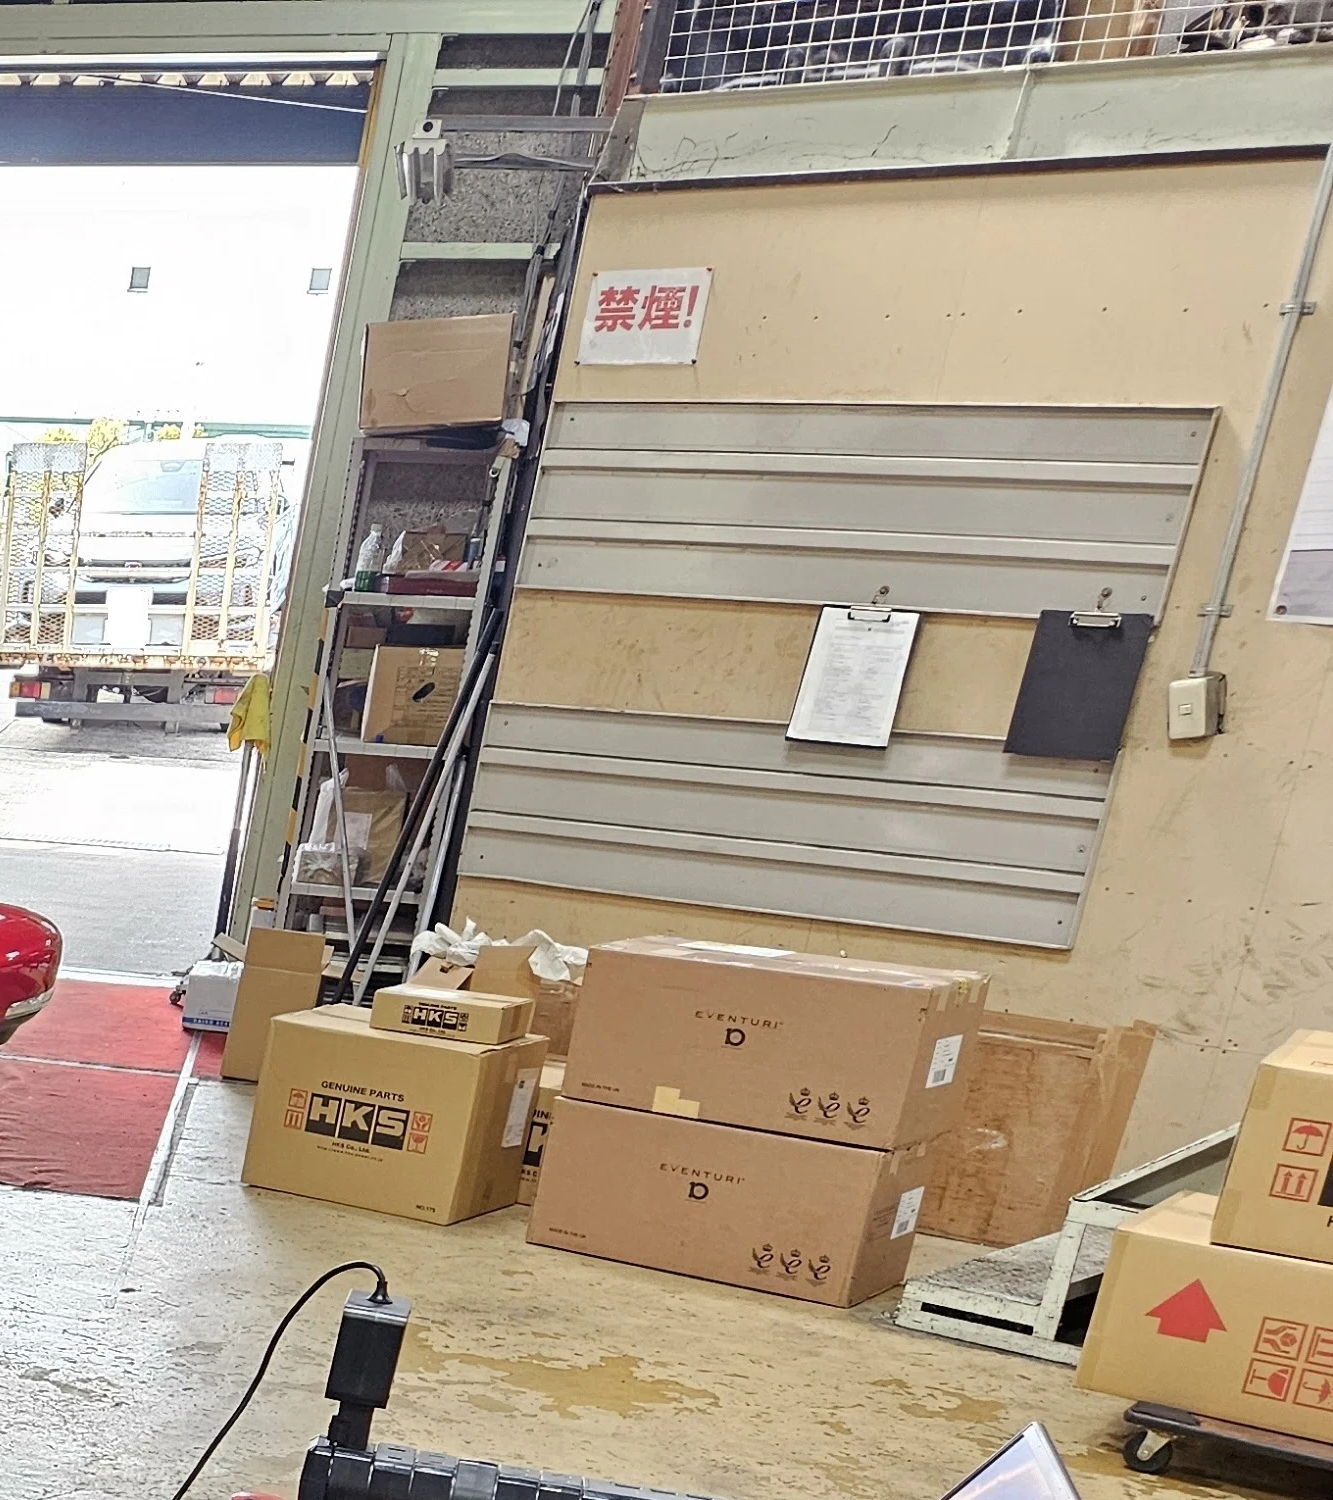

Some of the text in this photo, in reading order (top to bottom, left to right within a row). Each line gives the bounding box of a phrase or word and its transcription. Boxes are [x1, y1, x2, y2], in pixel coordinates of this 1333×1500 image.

[594, 285, 699, 332] 禁煙!
[413, 1007, 458, 1026] HKS
[695, 1010, 779, 1030] EVENTURI
[321, 1080, 405, 1102] GENUINE PARTS
[308, 1095, 408, 1139] HKS
[660, 1163, 741, 1184] EVENTURI
